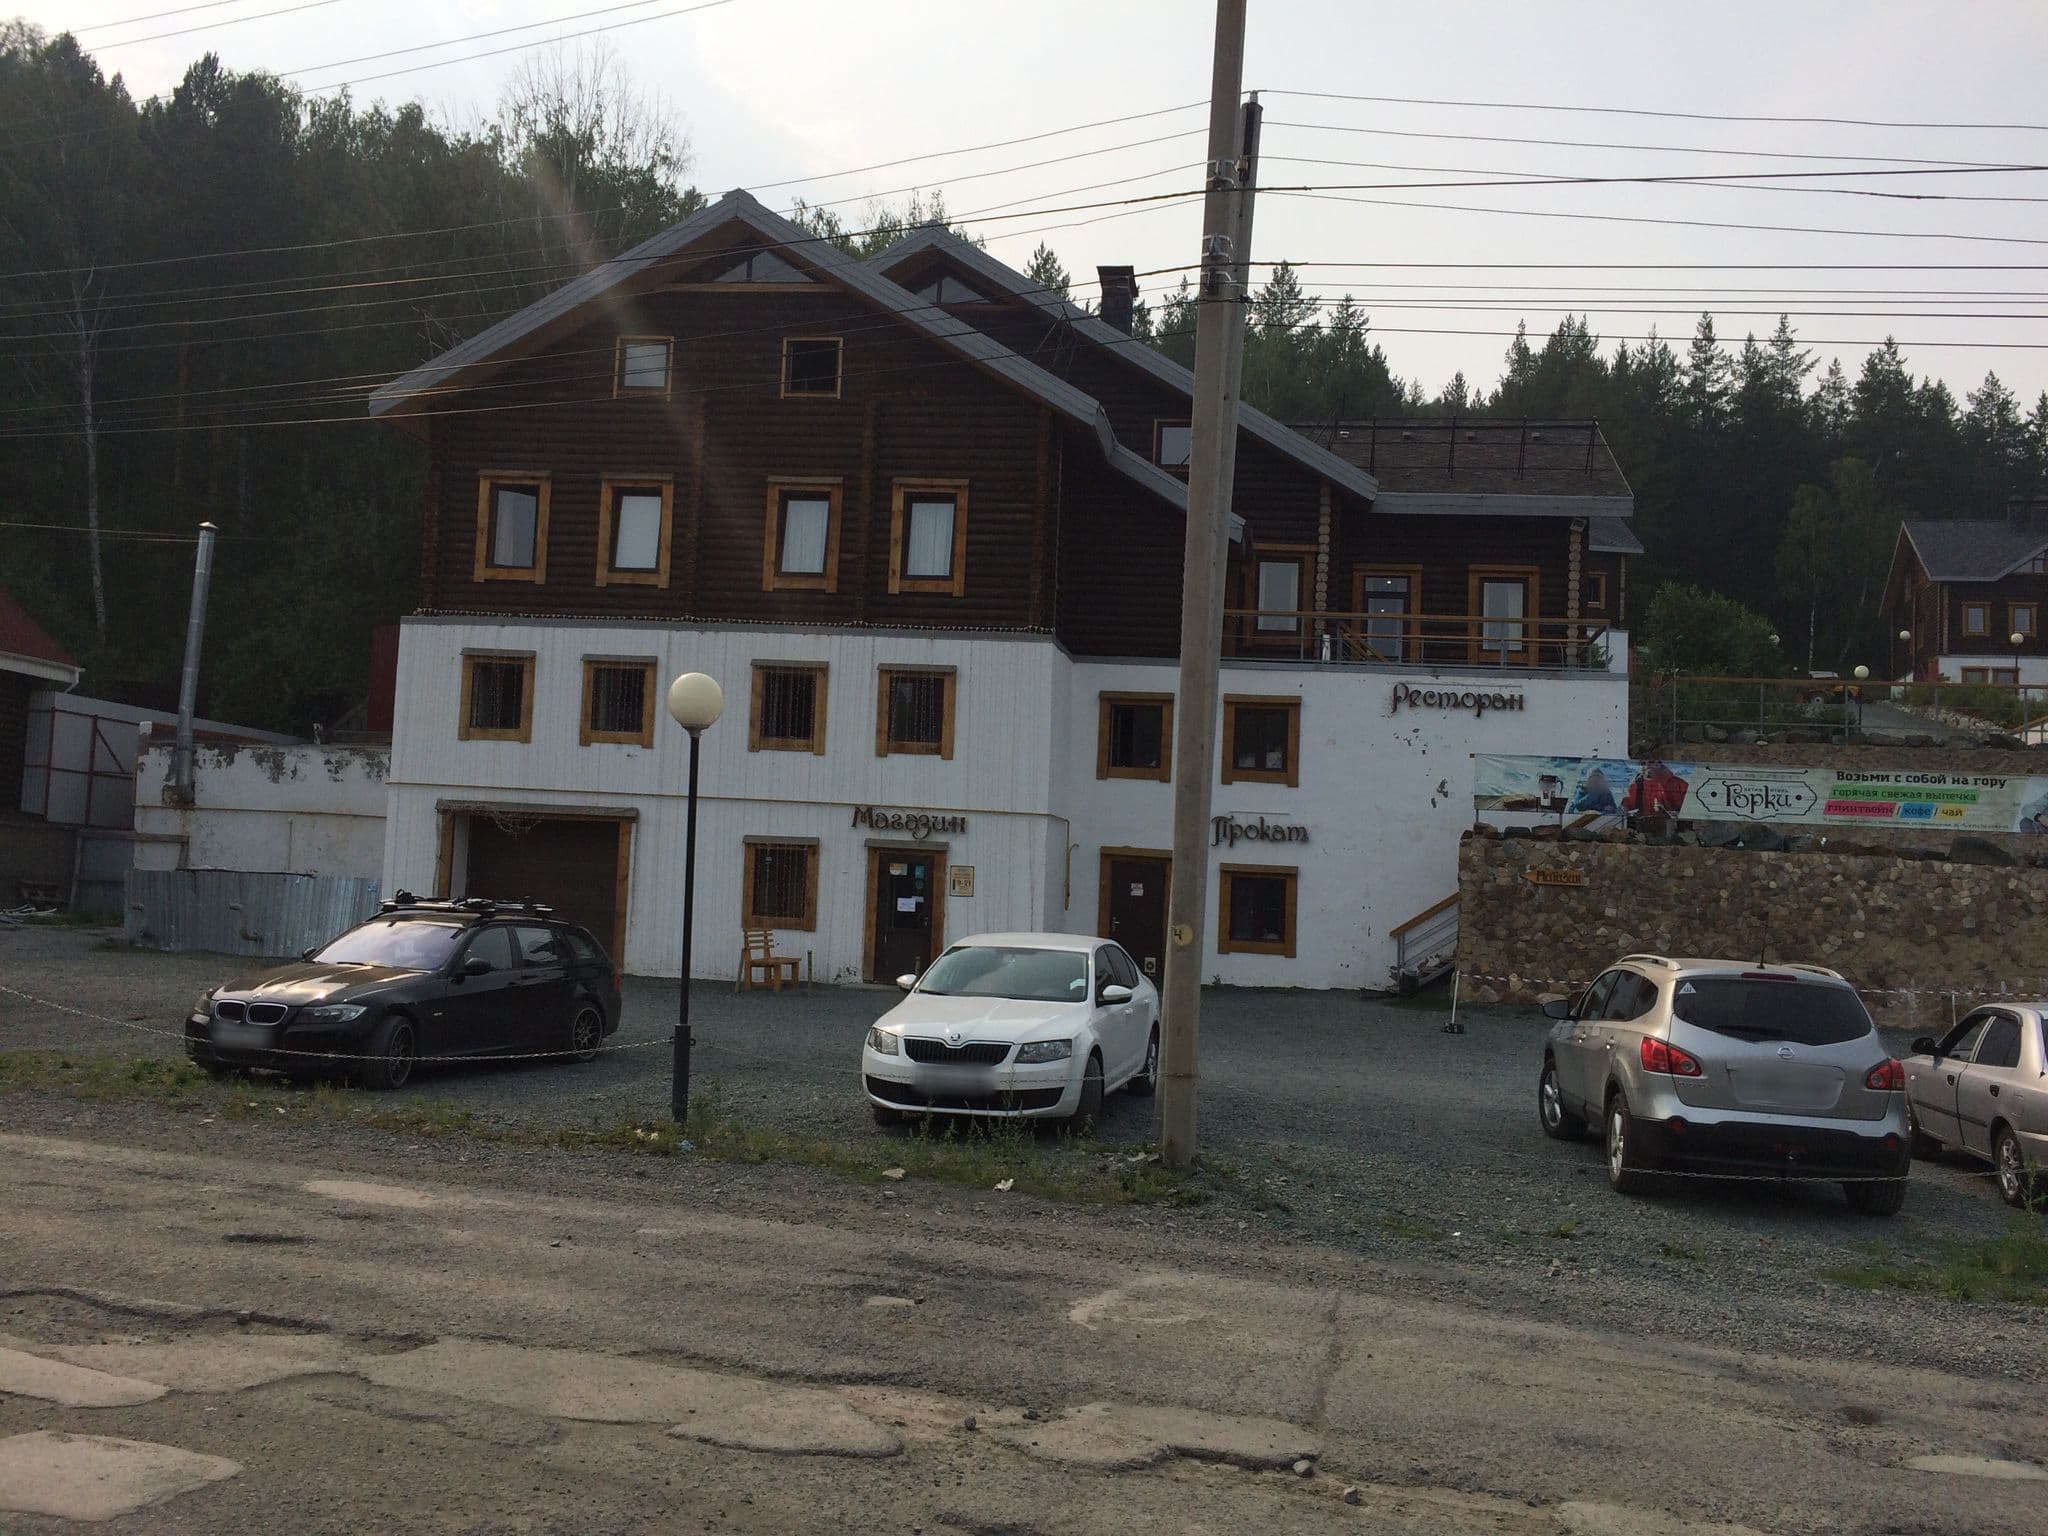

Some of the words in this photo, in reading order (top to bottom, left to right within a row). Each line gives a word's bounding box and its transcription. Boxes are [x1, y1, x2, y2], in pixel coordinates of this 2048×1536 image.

[1391, 682, 1524, 717] Ресторан
[1832, 788, 1878, 799] горячая
[1881, 790, 1922, 799] свежая
[1925, 791, 1977, 801] выпечка
[1836, 770, 1890, 783] Возьми
[1894, 774, 1902, 783] с
[1906, 773, 1947, 785] собой
[1951, 776, 1969, 786] на
[1973, 776, 2007, 789] гору
[1722, 781, 1792, 814] Горки
[1826, 803, 1894, 815] глинтвейн
[1903, 805, 1931, 818] кофе
[1941, 807, 1964, 817] чай
[851, 806, 966, 840] Магазин
[1211, 815, 1311, 848] Прокат
